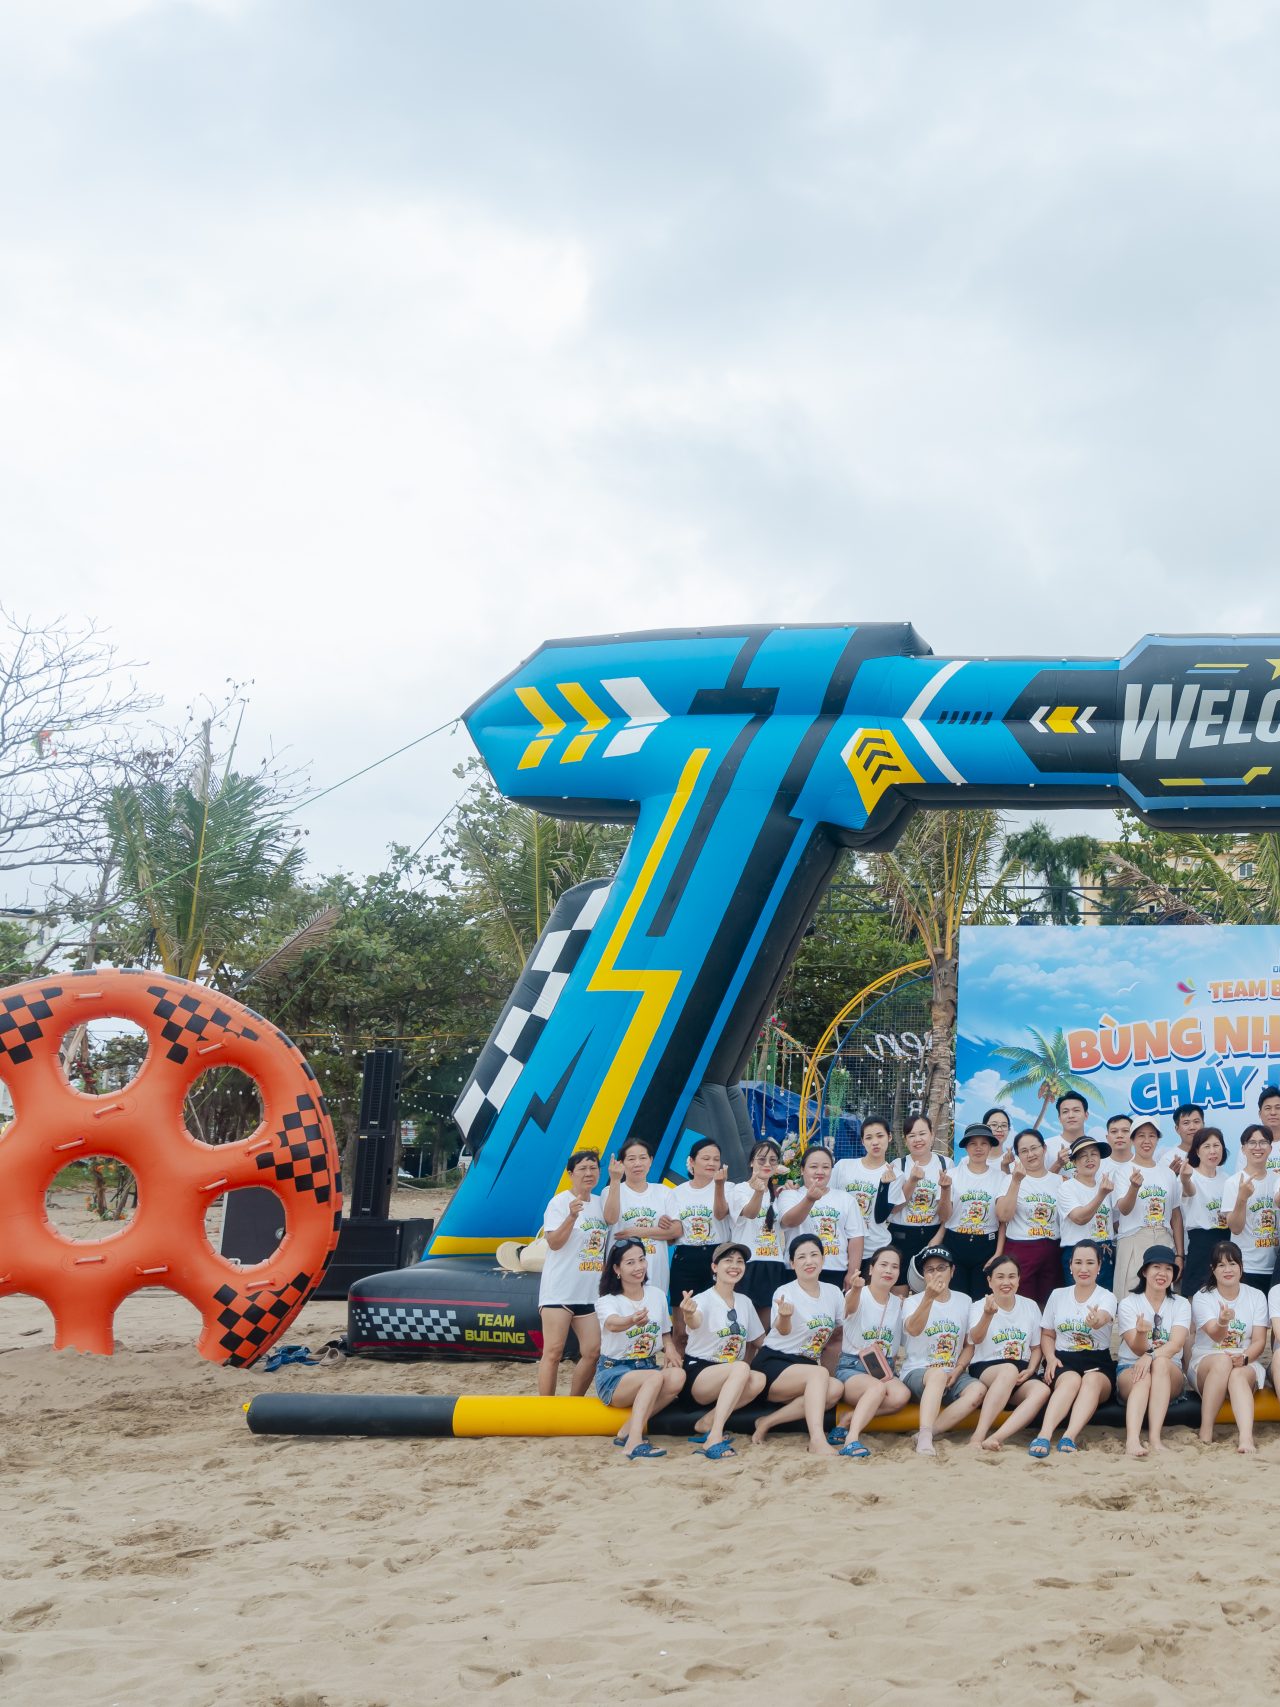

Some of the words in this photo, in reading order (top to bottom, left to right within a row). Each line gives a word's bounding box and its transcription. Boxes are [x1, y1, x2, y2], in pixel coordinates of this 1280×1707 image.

[1209, 979, 1267, 1002] TEAM
[1067, 1013, 1206, 1074] BÙNG
[1129, 1053, 1259, 1116] CHÁY
[477, 1313, 515, 1328] TEAM
[465, 1329, 525, 1344] BUILDING
